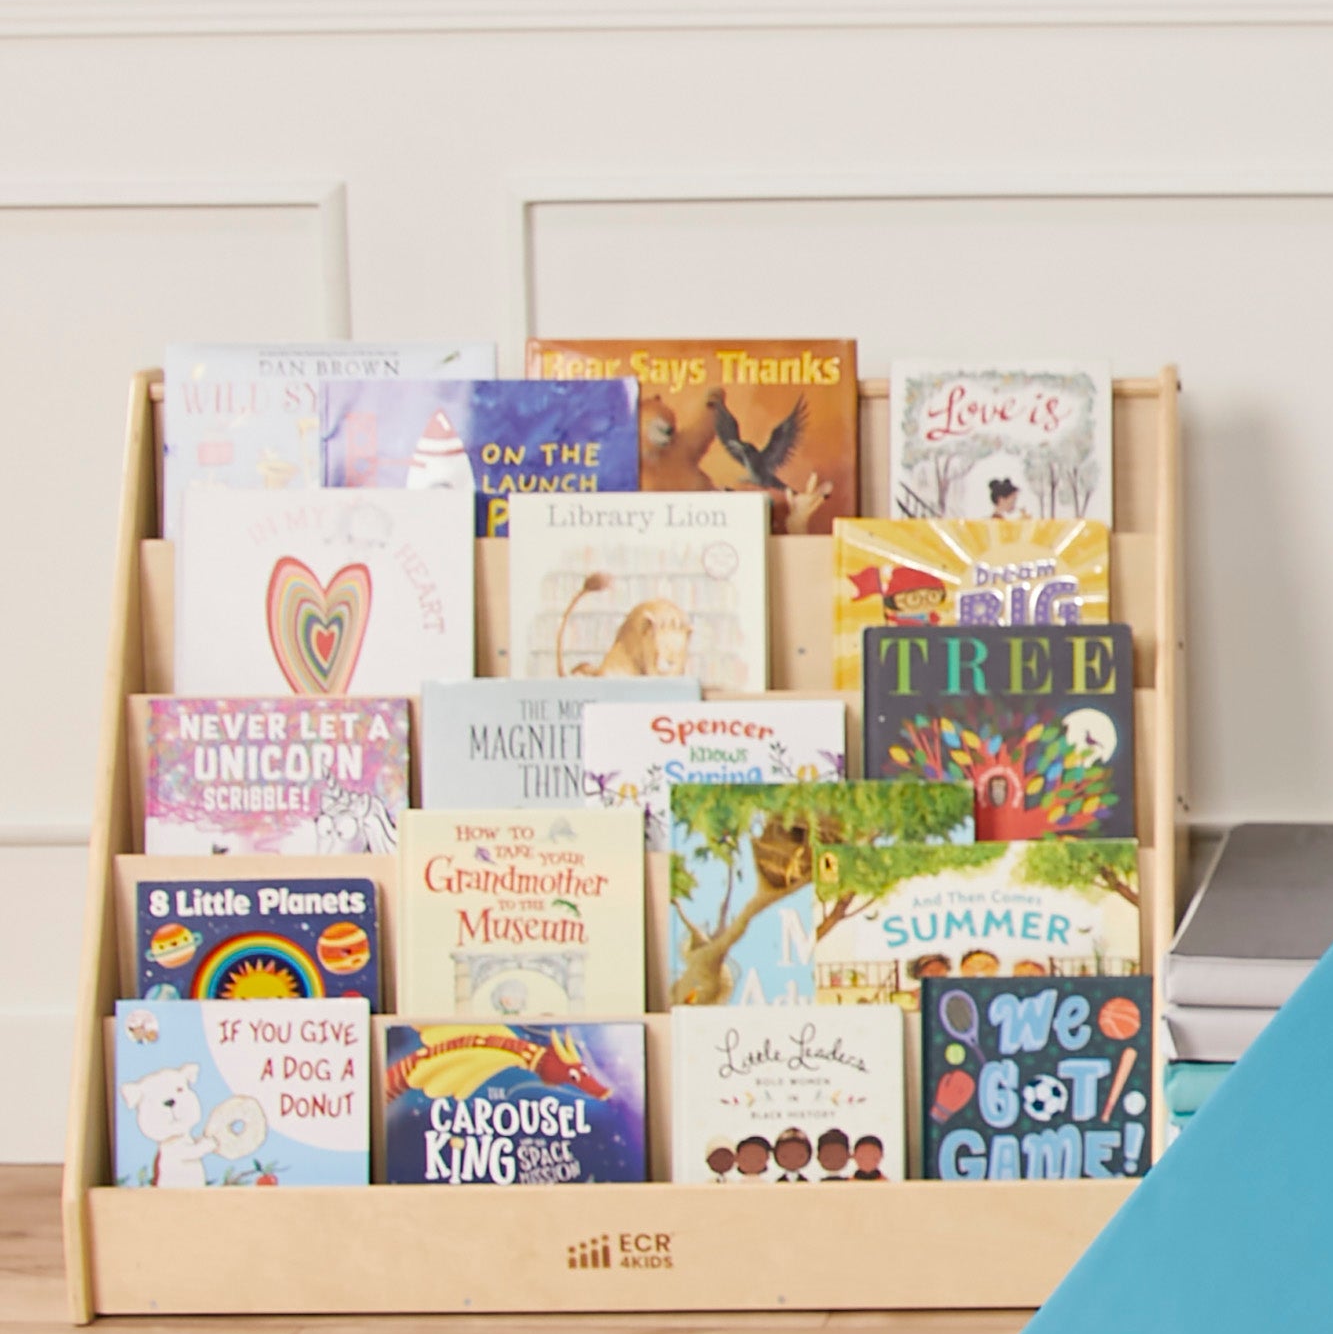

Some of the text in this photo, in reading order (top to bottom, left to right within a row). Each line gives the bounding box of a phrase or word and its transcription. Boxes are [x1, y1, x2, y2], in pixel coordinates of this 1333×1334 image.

[259, 359, 400, 376] DAN BROWN
[542, 349, 841, 394] Bear Says Thanks
[926, 384, 1072, 441] Love is
[481, 442, 600, 467] ON THE
[482, 472, 598, 494] LAUNCH
[546, 503, 728, 534] Library Lion
[393, 542, 446, 634] HEART
[975, 561, 1057, 586] Dream
[879, 635, 1117, 696] TREE
[519, 699, 598, 721] THE MO
[179, 711, 391, 742] NEVER LET A
[650, 716, 775, 746] Spencer
[193, 743, 364, 782] UNICORN
[519, 764, 585, 799] THIN
[508, 826, 535, 841] TO
[424, 855, 610, 898] Grandmother
[149, 887, 367, 918] 8 Little Planets
[498, 899, 545, 912] TO THE
[912, 891, 1043, 909] And Then Comes
[882, 908, 1072, 949] SUMMER
[218, 1019, 359, 1047] IF YOU GIVE
[986, 988, 1092, 1055] We
[714, 1022, 870, 1079] Little Leaders
[259, 1055, 355, 1082] A DOG A
[280, 1091, 355, 1118] DONUT
[430, 1096, 592, 1139] CAROUSEL
[516, 1139, 574, 1172] SPACE
[937, 1121, 1146, 1181] GAME!
[619, 1232, 672, 1253] ECR
[619, 1255, 674, 1269] 4KIDS
